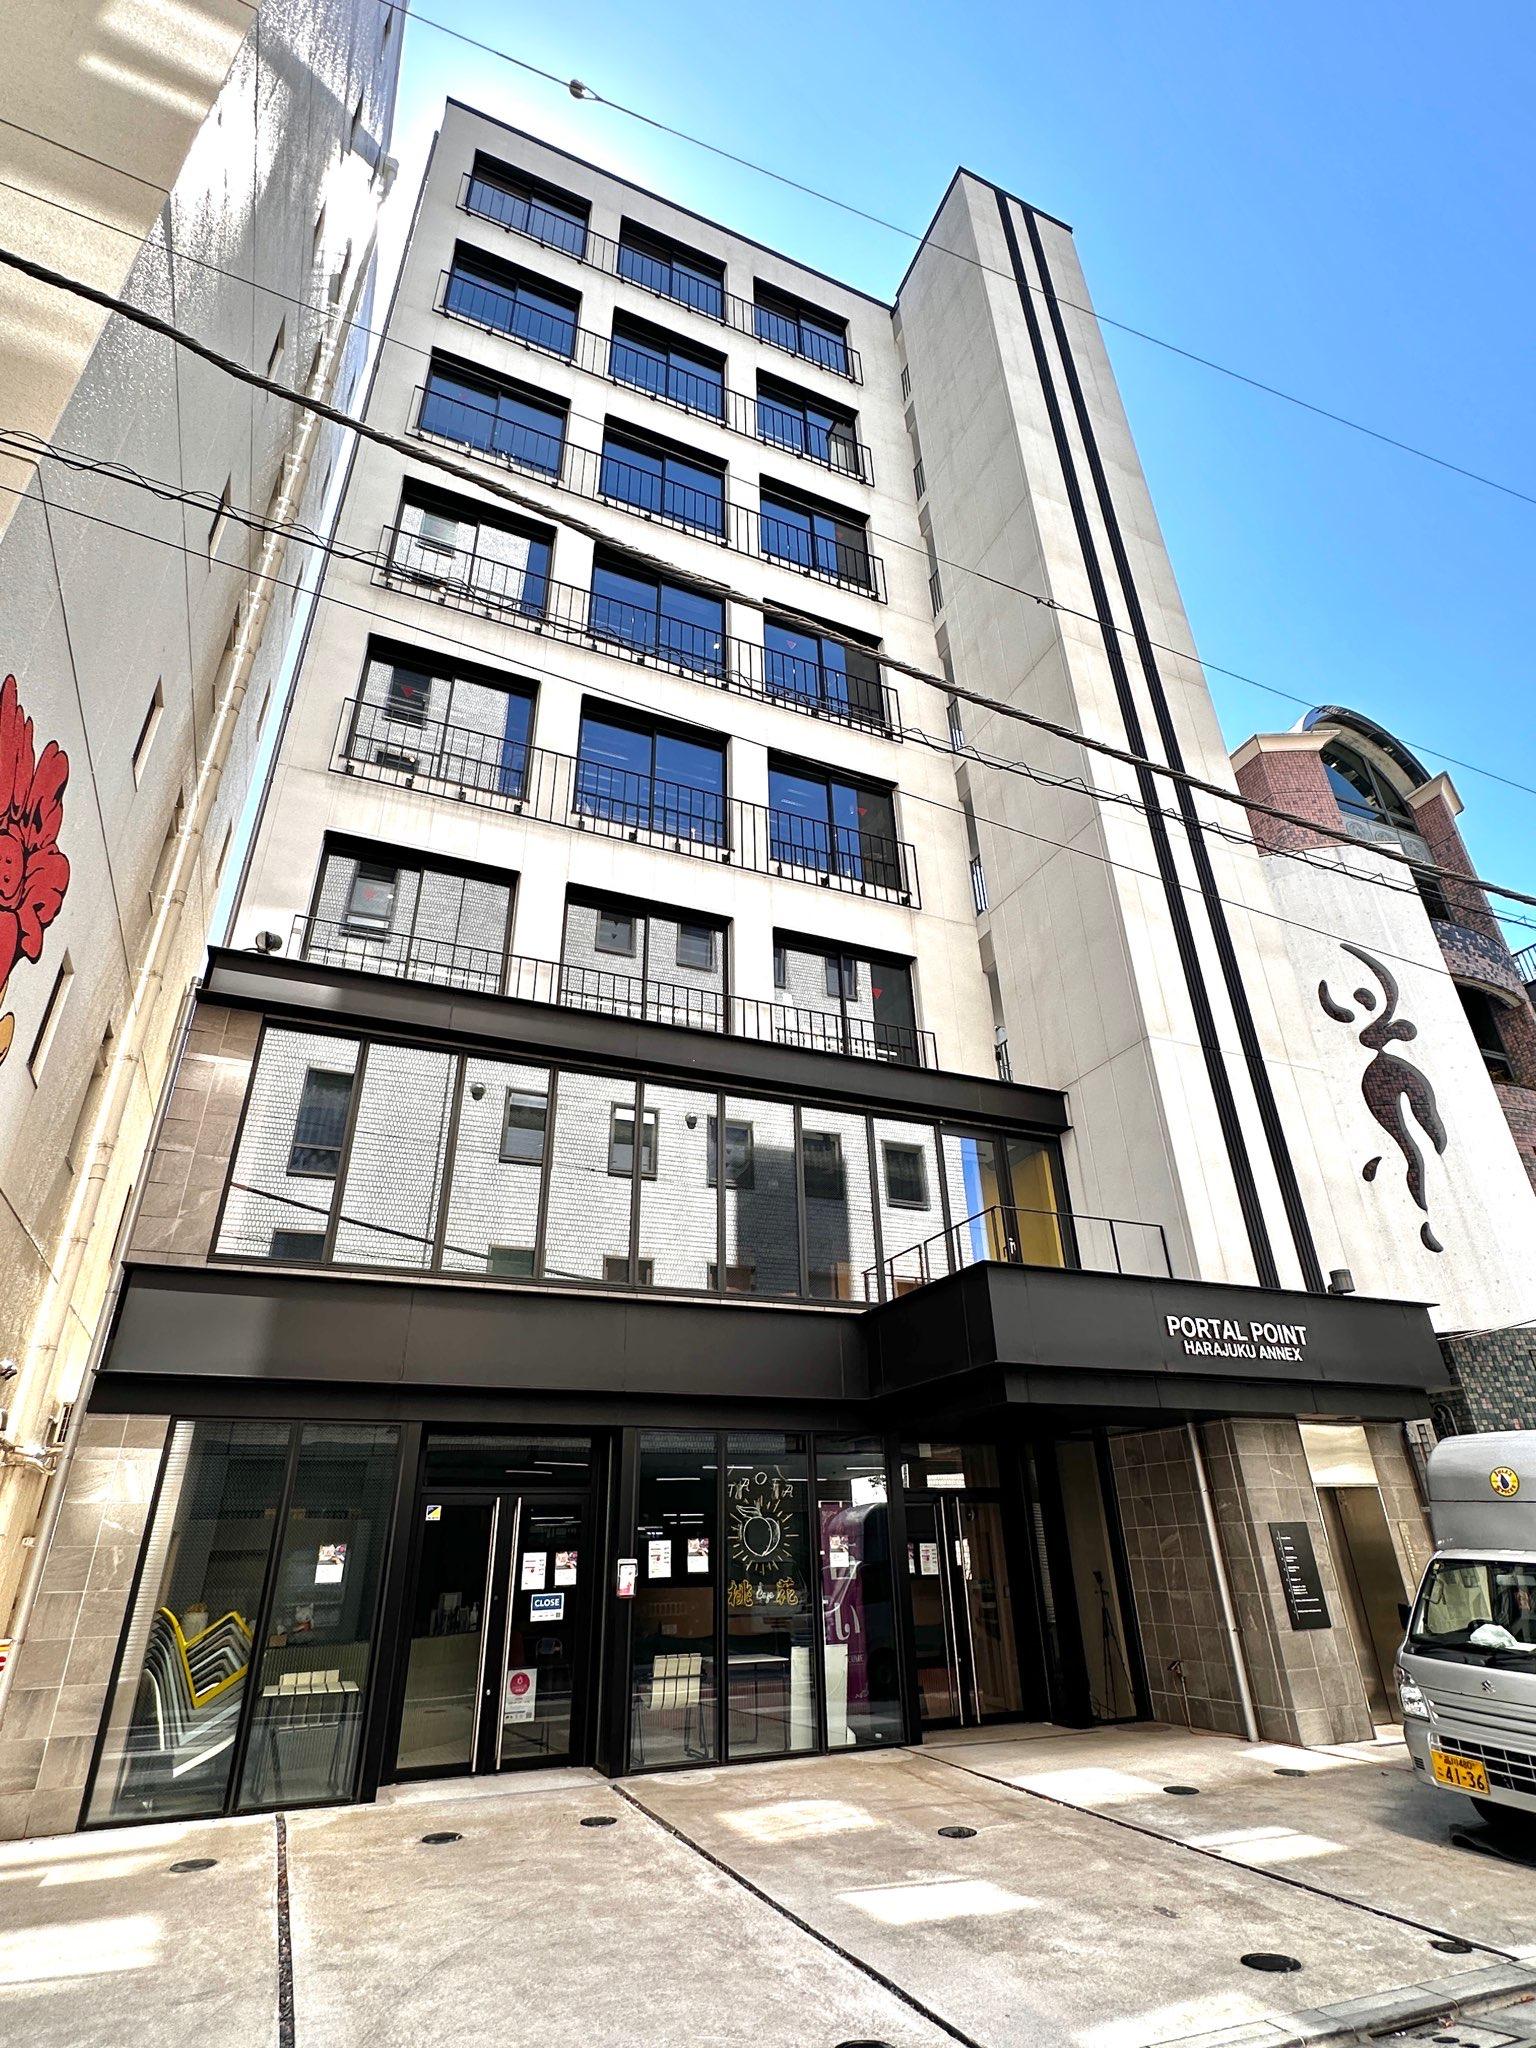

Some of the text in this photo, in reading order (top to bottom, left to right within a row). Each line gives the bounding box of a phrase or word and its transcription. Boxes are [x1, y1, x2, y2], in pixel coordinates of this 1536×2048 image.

[1166, 1315, 1307, 1346] PORTAL POINT
[1184, 1340, 1303, 1362] HARAJUKU ANNEX
[534, 1598, 560, 1608] CLOSE
[1446, 1766, 1485, 1790] 41-36
